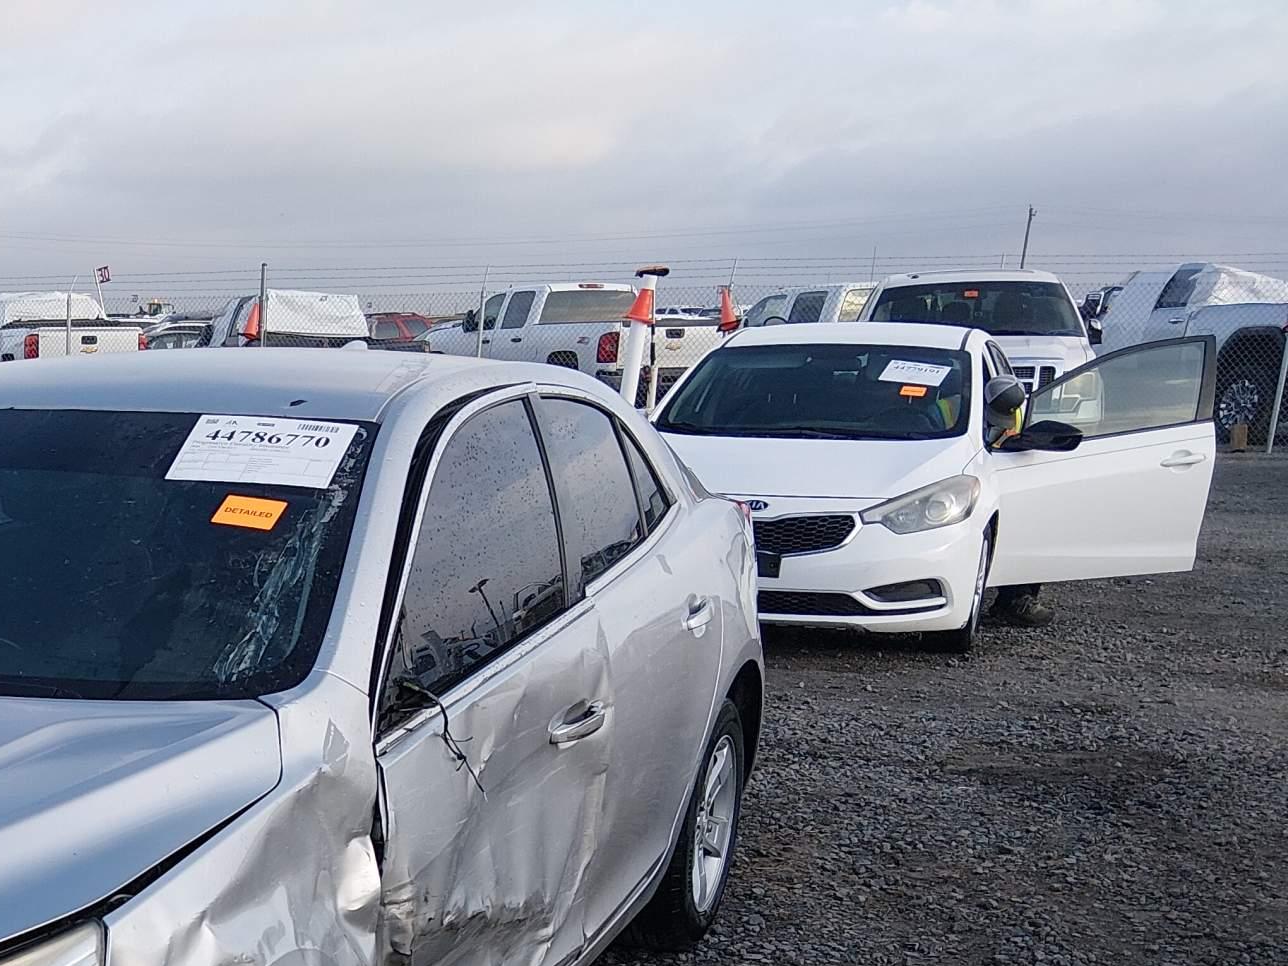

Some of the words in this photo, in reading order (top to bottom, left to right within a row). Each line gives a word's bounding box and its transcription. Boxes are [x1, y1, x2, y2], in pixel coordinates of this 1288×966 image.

[96, 267, 110, 282] 30
[205, 429, 331, 449] 44786770
[224, 506, 273, 519] DETAILED
